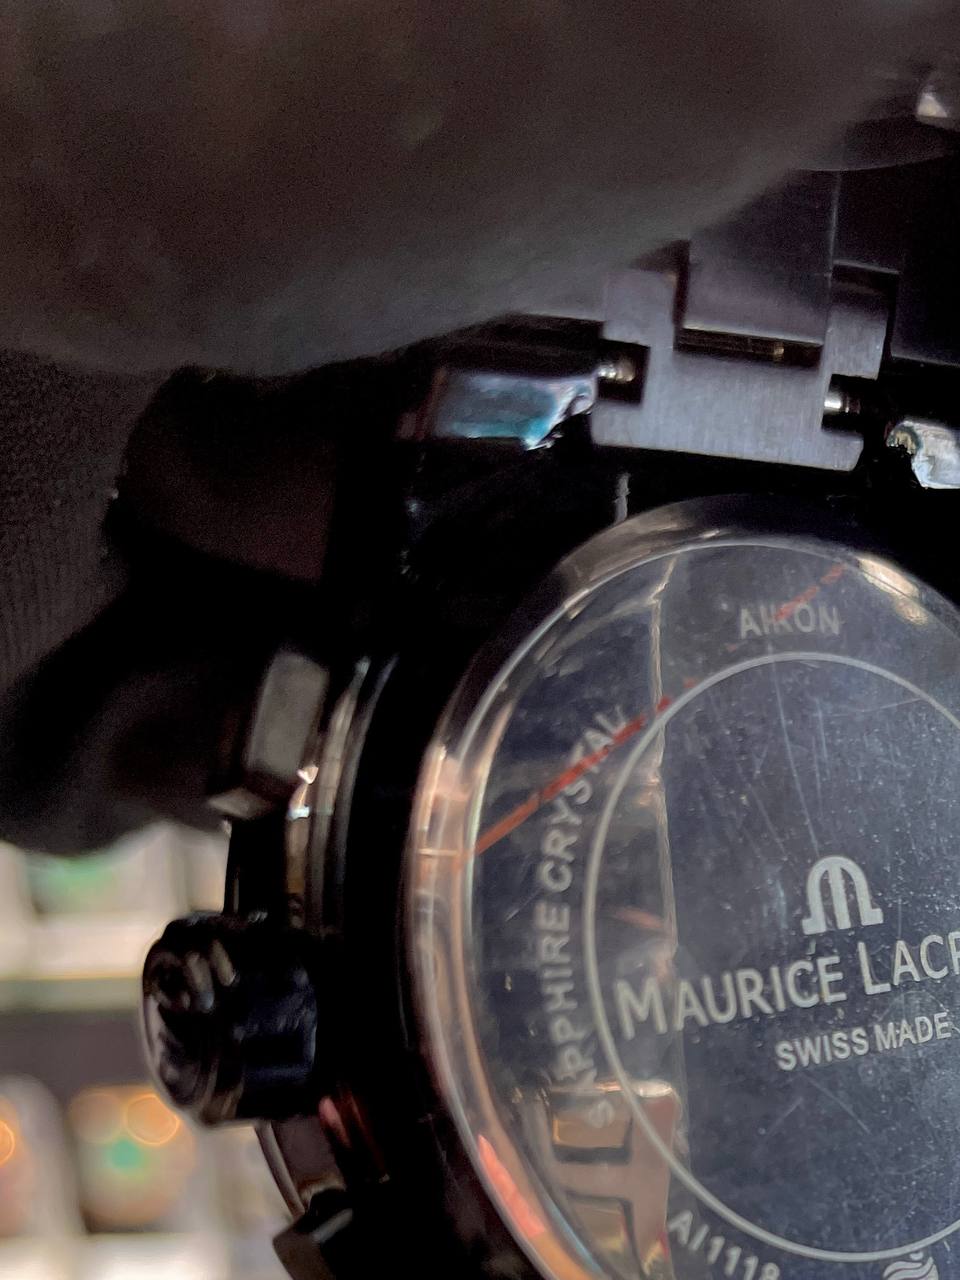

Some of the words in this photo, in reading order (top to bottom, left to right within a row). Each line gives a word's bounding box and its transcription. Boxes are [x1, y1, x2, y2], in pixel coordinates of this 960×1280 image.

[739, 602, 840, 639] AIKON
[538, 705, 627, 892] CRYSTAL
[615, 956, 847, 1040] MAURICE
[775, 1028, 869, 1071] SWISS
[875, 1012, 952, 1053] MADE
